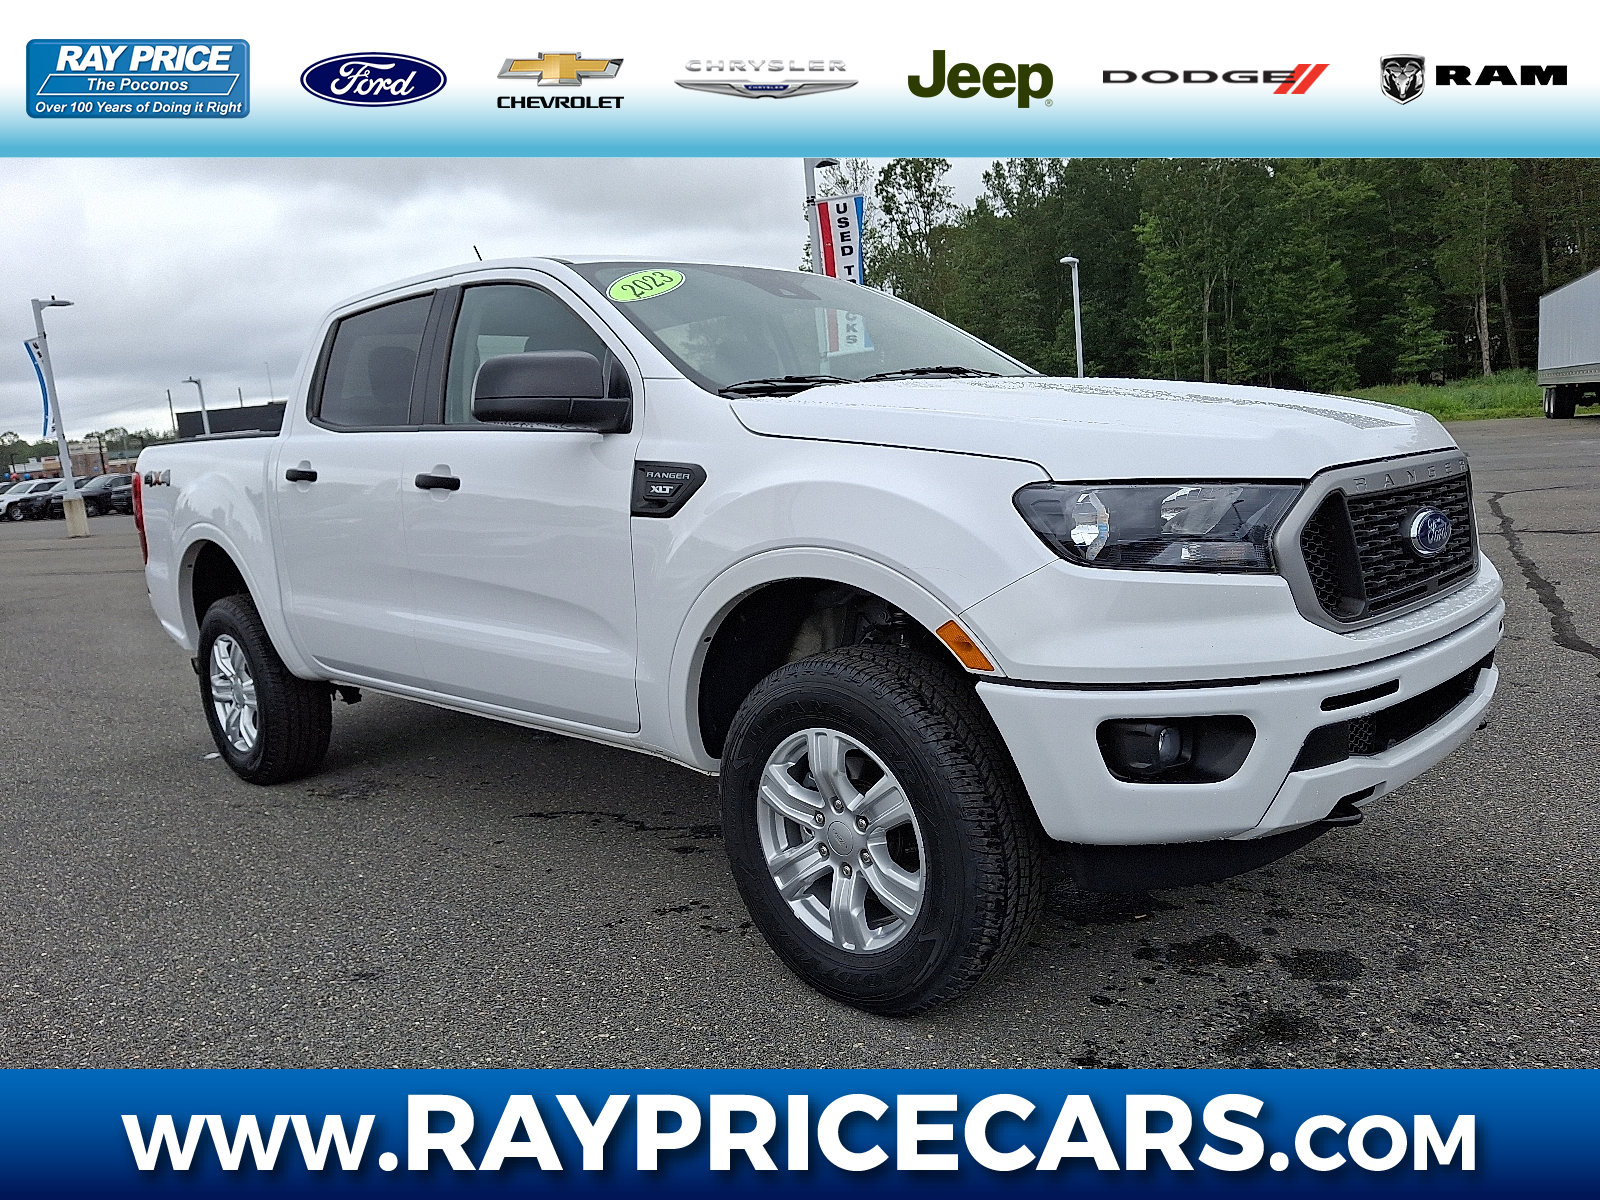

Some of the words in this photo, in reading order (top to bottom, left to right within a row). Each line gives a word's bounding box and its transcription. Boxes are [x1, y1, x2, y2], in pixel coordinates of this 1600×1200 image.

[835, 202, 854, 257] USED
[621, 271, 674, 298] 2023
[646, 471, 690, 480] RANGER
[1353, 459, 1468, 493] RANGER
[650, 485, 674, 494] XLT
[1427, 518, 1448, 545] Ford
